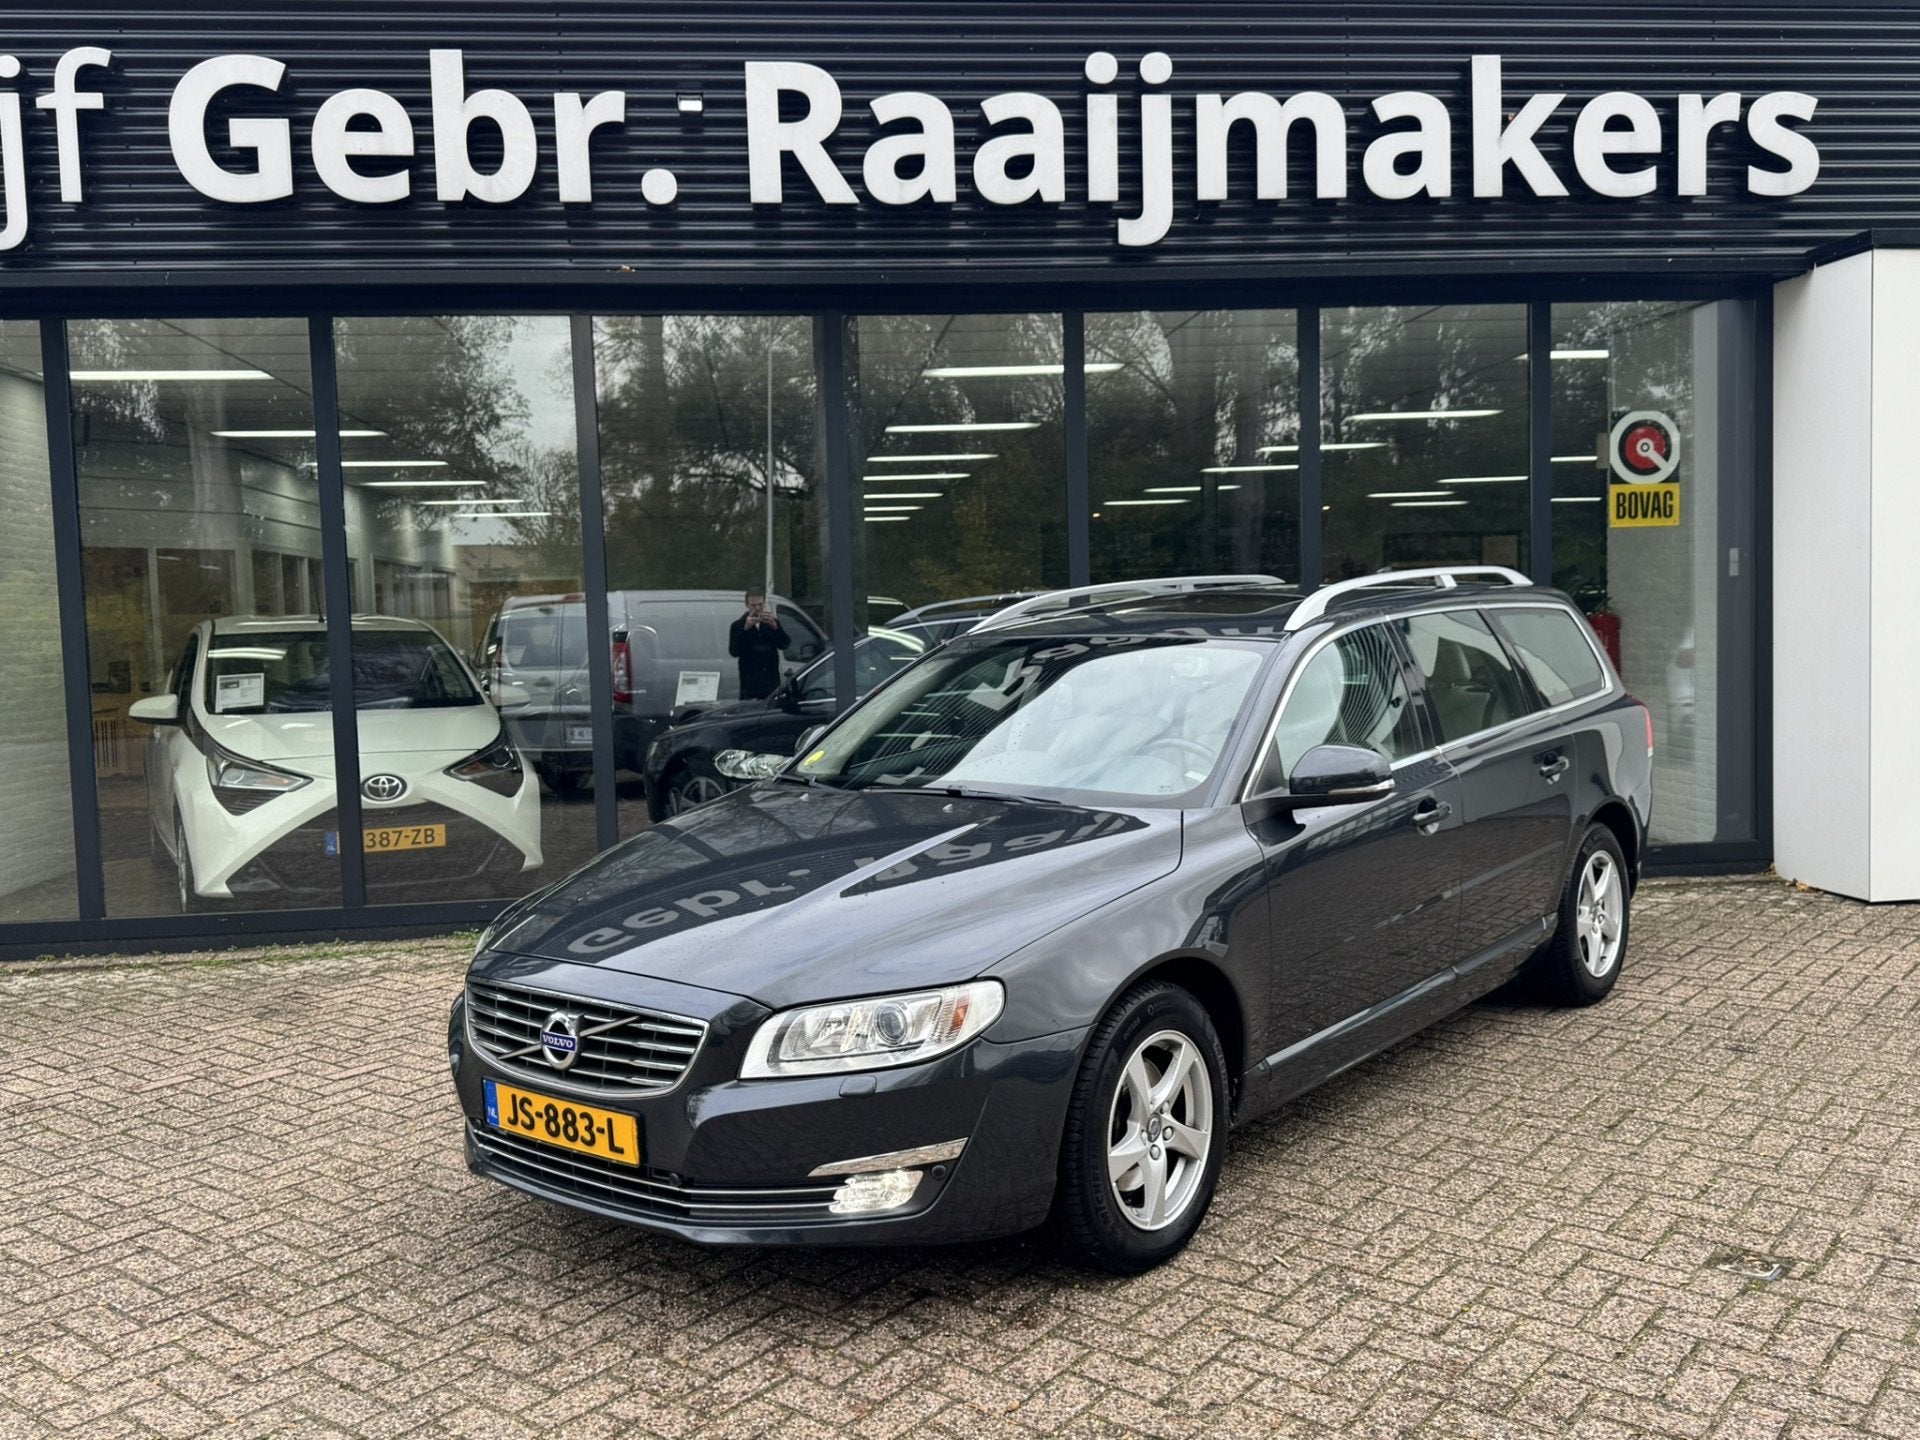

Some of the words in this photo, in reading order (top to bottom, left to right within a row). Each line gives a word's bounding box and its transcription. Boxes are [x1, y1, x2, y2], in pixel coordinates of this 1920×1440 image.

[168, 49, 678, 205] Gebr.
[745, 51, 1820, 247] Raaijmakers
[1616, 490, 1673, 519] BOVAG
[365, 828, 435, 849] 387-ZB
[542, 1034, 573, 1048] VOLVO
[487, 1106, 498, 1118] NL
[507, 1093, 625, 1155] JS-883-L
